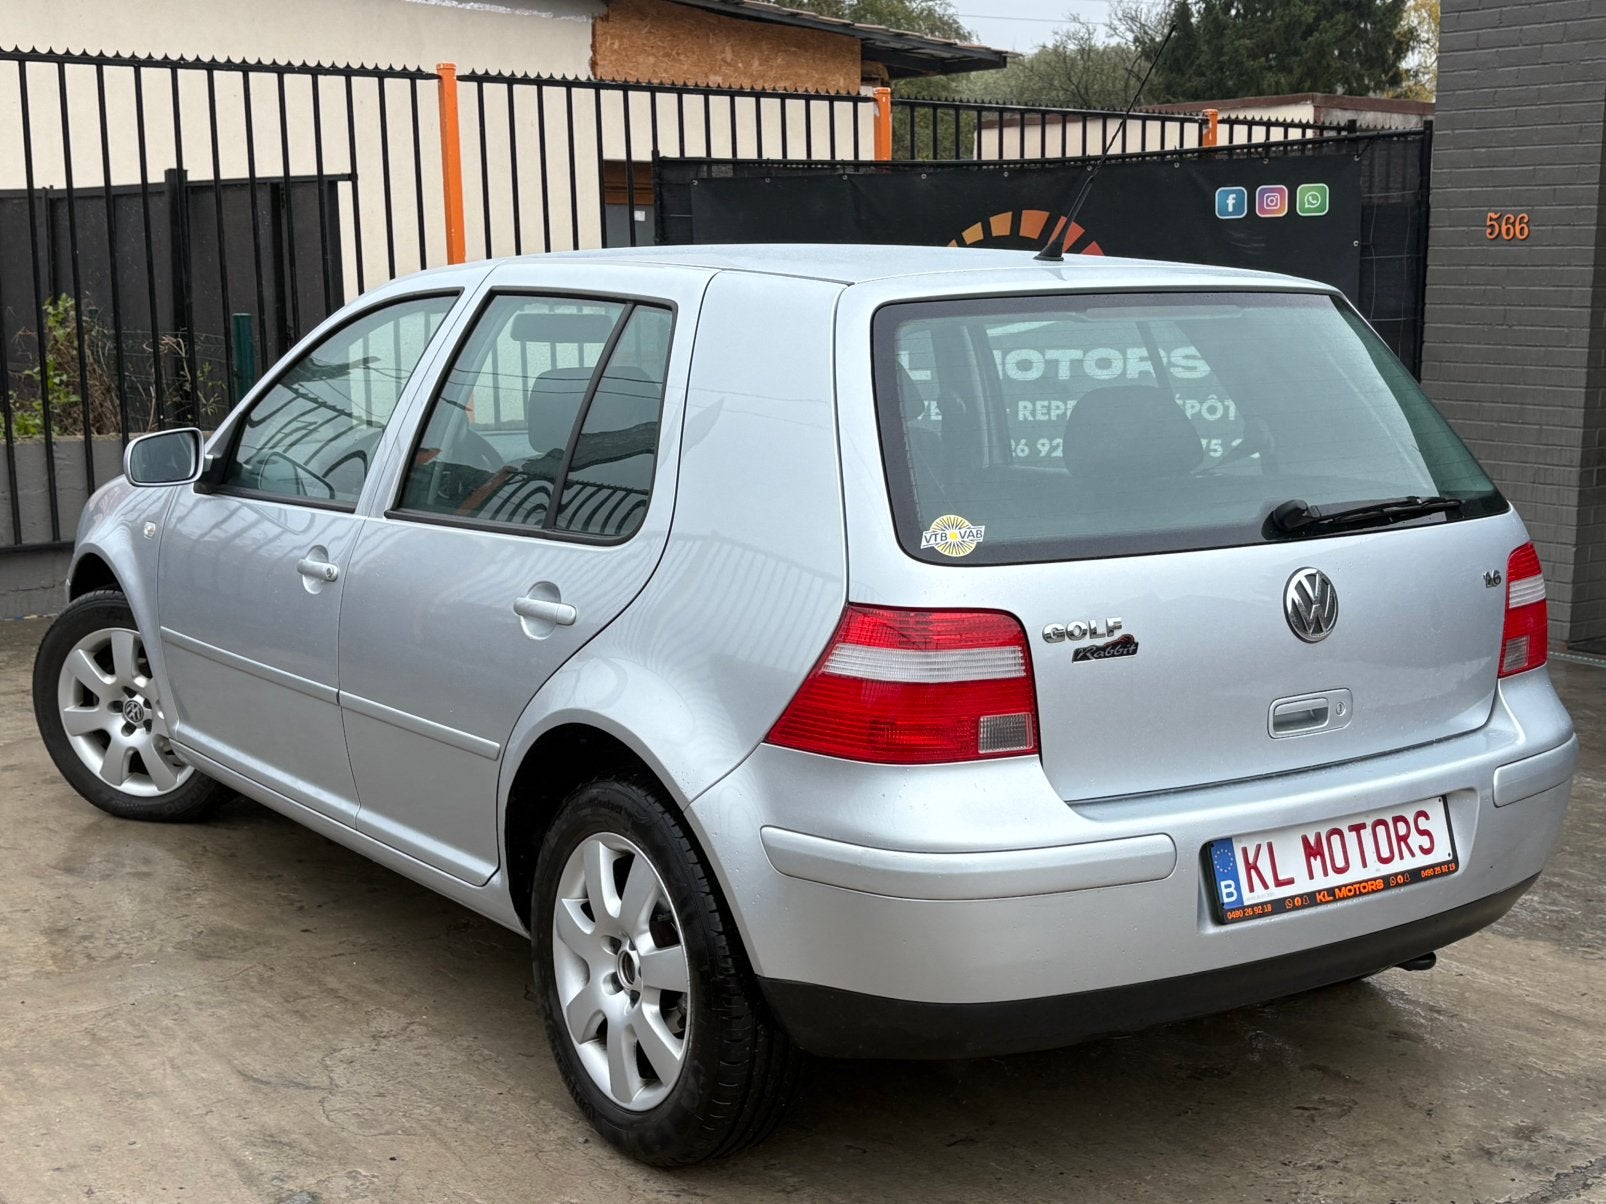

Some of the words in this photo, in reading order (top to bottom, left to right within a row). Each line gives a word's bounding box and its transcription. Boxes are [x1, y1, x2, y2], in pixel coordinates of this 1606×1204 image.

[1486, 212, 1530, 240] 566
[993, 347, 1211, 381] OTORS
[924, 532, 948, 543] VTB
[959, 529, 983, 539] VAB
[1042, 616, 1122, 643] GOLF
[1076, 644, 1137, 660] Rabbit
[1241, 841, 1295, 893] KL
[1301, 810, 1435, 880] MOTORS
[1220, 879, 1237, 903] B
[1316, 891, 1333, 903] KL
[1335, 879, 1384, 898] MOTORS
